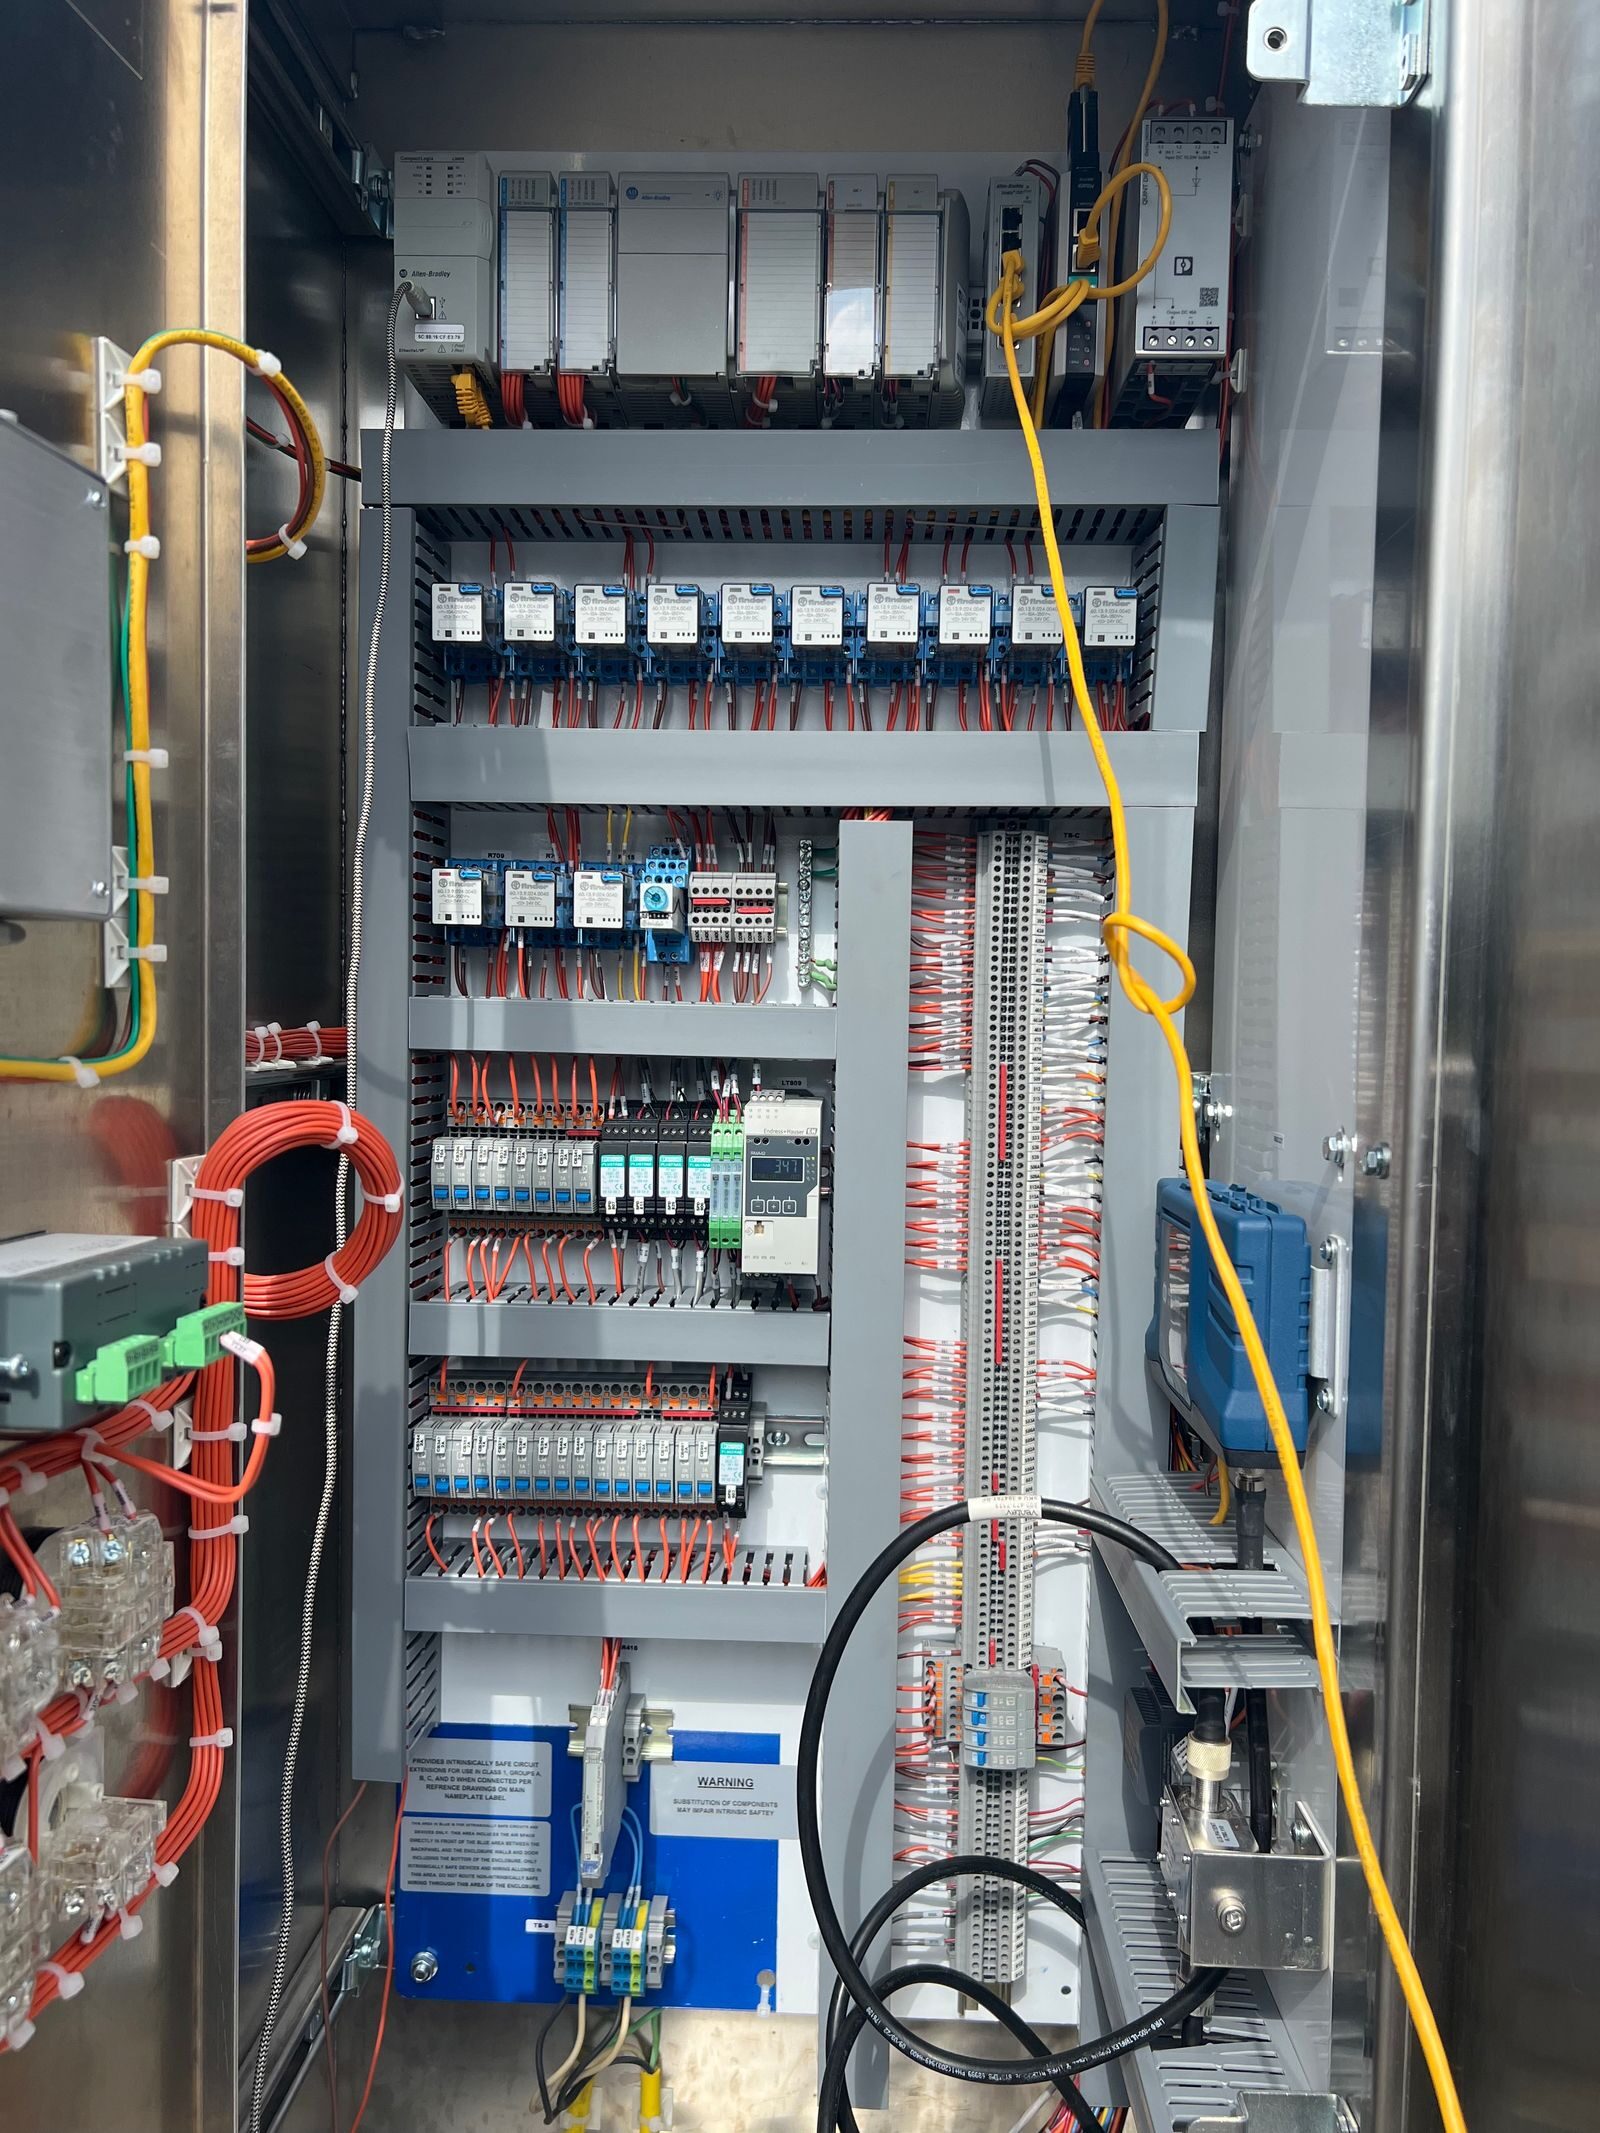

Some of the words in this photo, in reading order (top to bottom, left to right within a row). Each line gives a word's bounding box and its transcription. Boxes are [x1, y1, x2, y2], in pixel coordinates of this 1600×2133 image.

[411, 270, 450, 278] Allen-Bradley
[764, 1128, 804, 1136] Endress+Hauser
[774, 1160, 798, 1174] 347
[446, 1759, 494, 1767] INTRINSICALLY
[697, 1777, 754, 1787] WARNING
[733, 1800, 778, 1808] COMPONENTS
